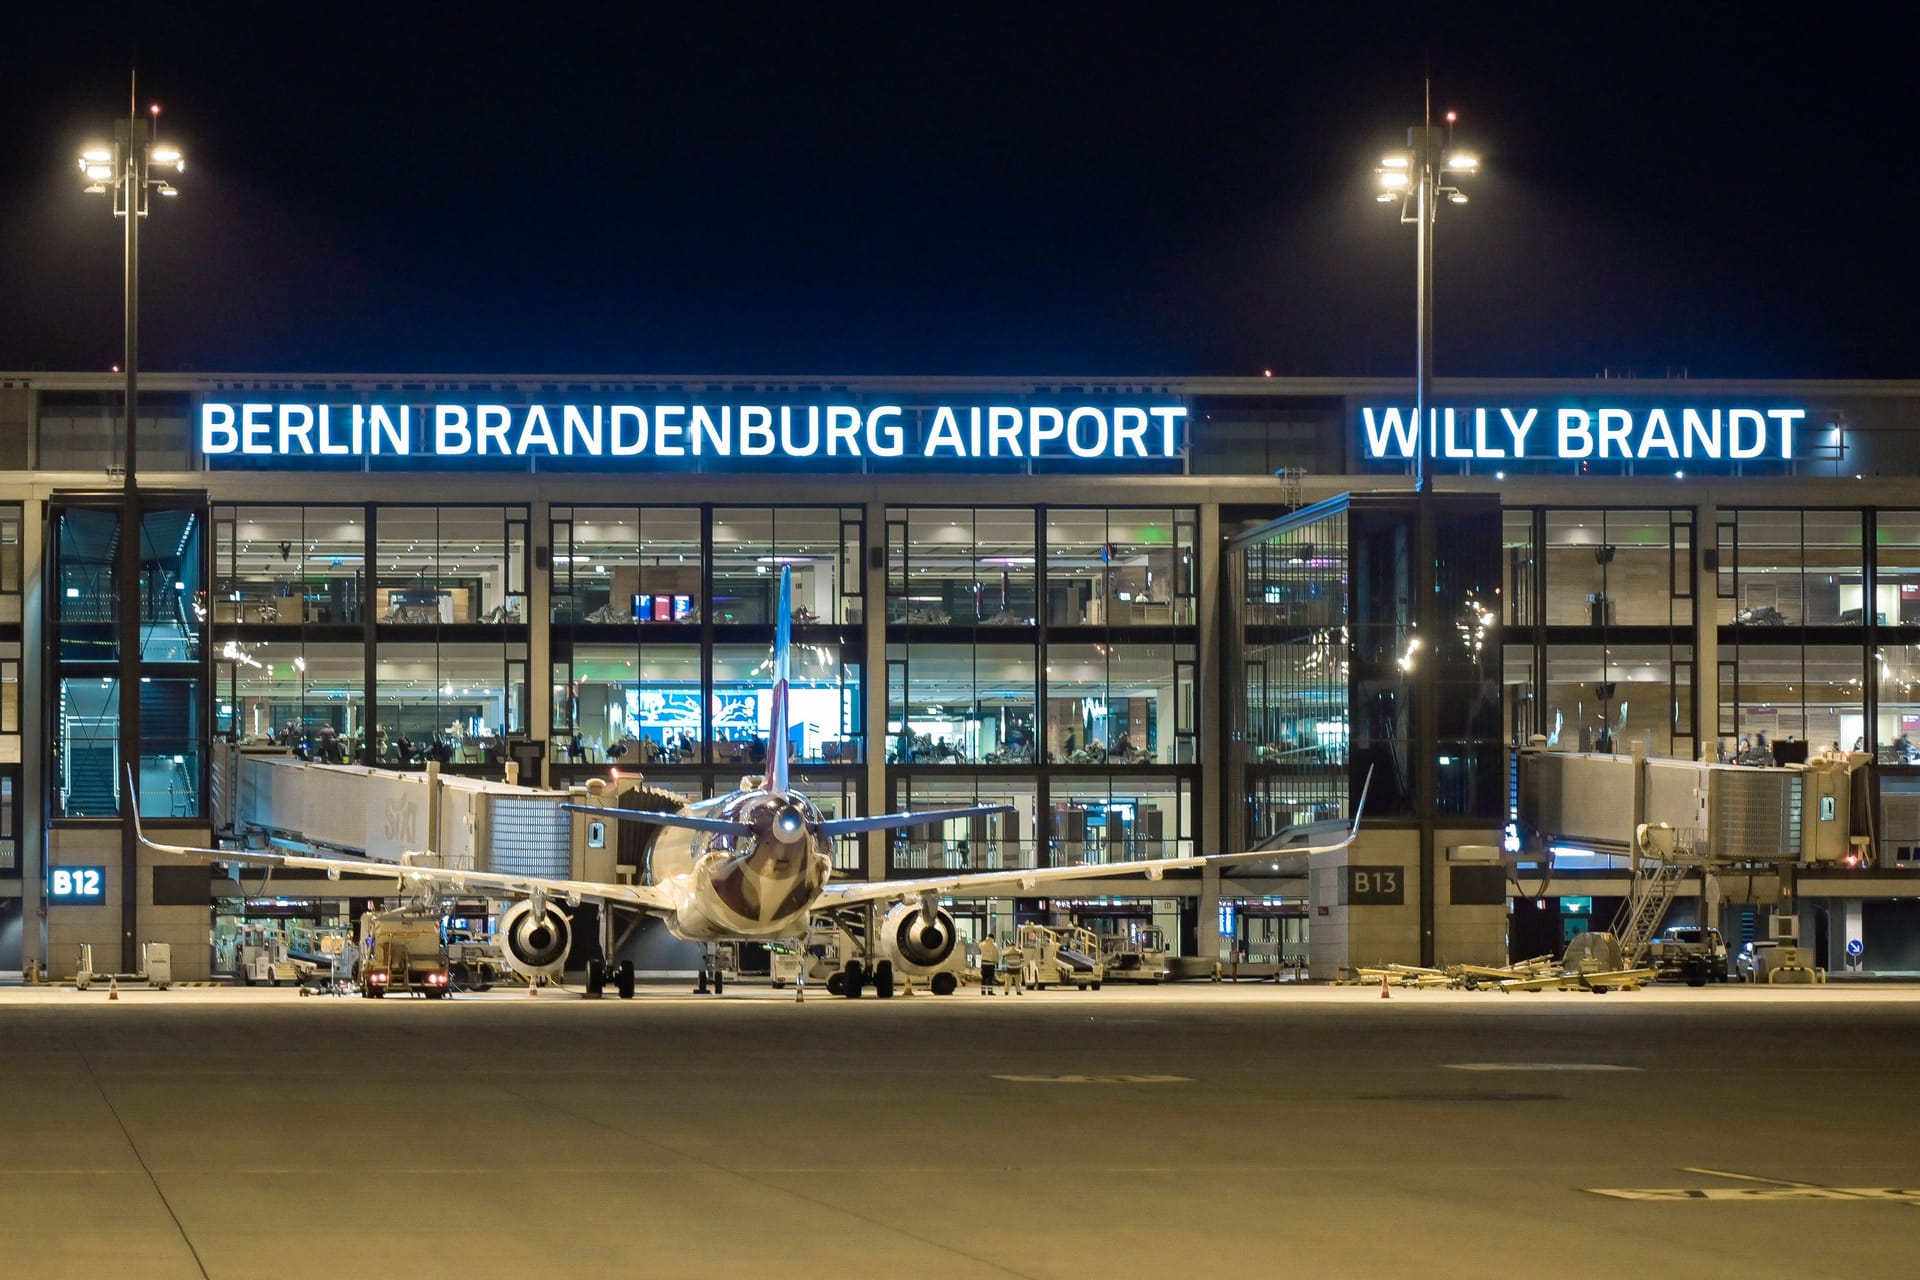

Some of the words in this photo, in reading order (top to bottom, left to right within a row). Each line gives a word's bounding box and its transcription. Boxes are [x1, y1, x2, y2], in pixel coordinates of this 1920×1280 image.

[202, 403, 410, 455] BERLIN
[435, 404, 904, 457] BRANDENBURG
[924, 405, 1188, 457] AIRPORT
[1362, 407, 1538, 458] WILLY
[1558, 408, 1805, 459] BRANDT
[53, 870, 100, 895] B12
[1354, 872, 1397, 893] B13
